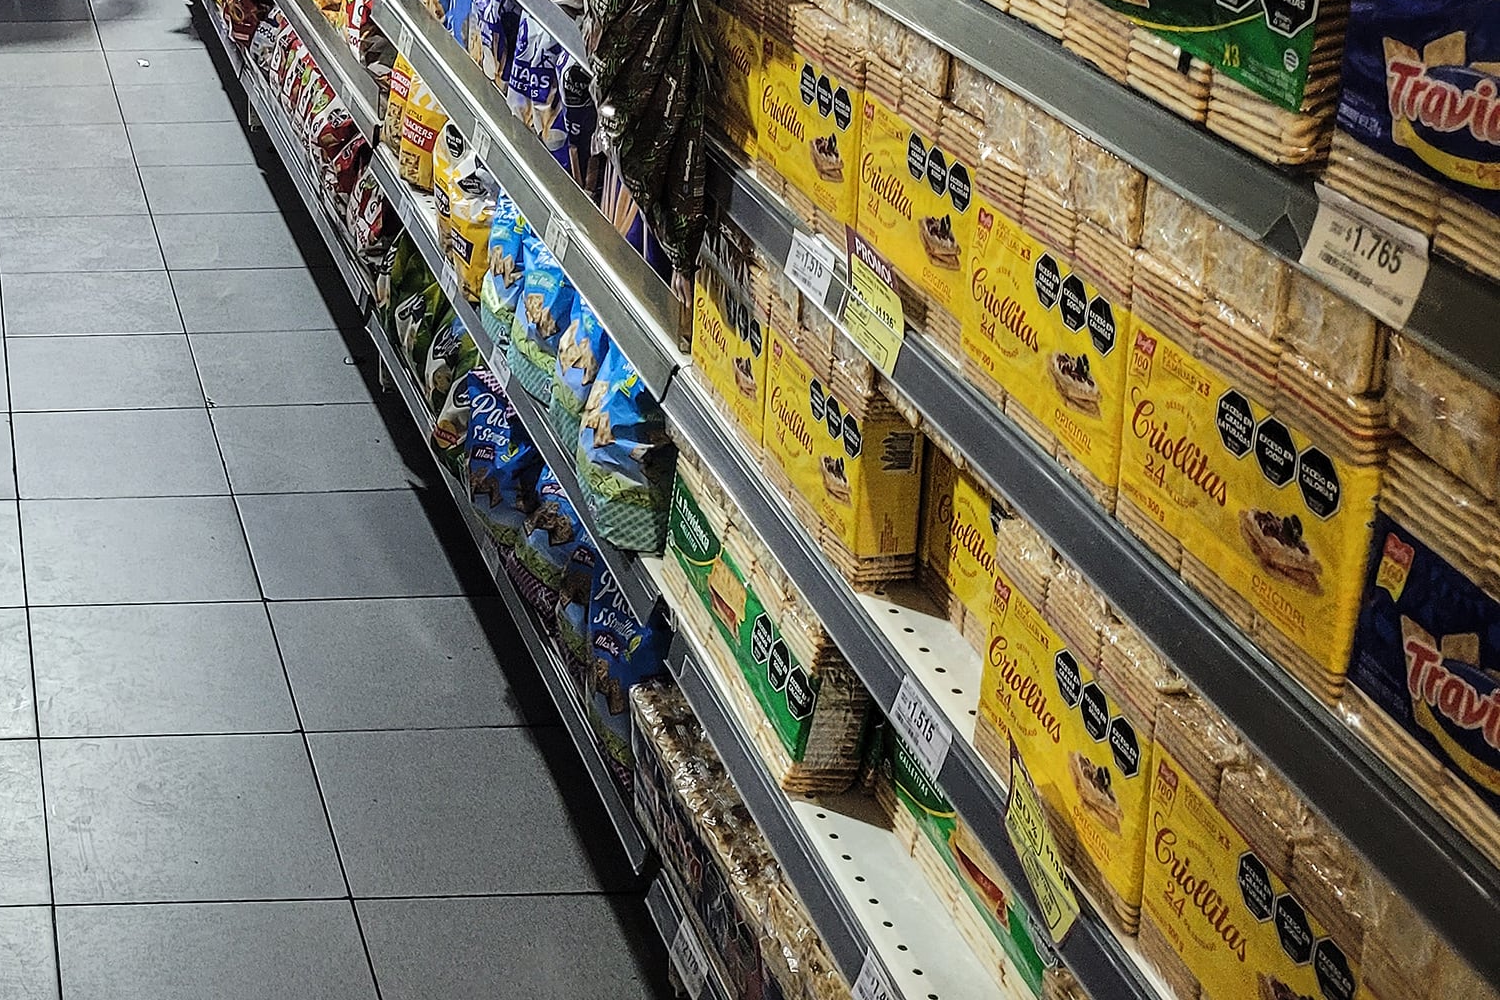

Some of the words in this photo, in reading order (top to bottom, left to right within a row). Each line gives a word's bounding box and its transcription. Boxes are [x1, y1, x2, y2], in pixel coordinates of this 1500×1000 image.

[404, 118, 434, 140] RACKERS
[761, 79, 806, 143] Criollitas
[861, 145, 913, 221] Criollitas
[855, 236, 894, 288] PROMO!
[971, 256, 1039, 353] Criollitas
[1089, 310, 1106, 328] EXCESO
[1106, 321, 1114, 334] EN
[980, 313, 996, 344] 24
[1133, 352, 1149, 371] 160
[1197, 379, 1210, 397] x3
[770, 379, 815, 455] Criollitas
[1054, 408, 1092, 449] ORIGINAL
[1221, 400, 1243, 423] EXCESO
[1243, 416, 1253, 428] EN
[1131, 387, 1228, 508] Criollitas
[1259, 433, 1283, 456] EXCESO
[1283, 450, 1294, 463] EN
[1265, 447, 1285, 466] SODIO
[1144, 454, 1166, 491] 24
[1301, 462, 1326, 485] EXCESO
[1327, 478, 1338, 494] EN
[675, 488, 684, 507] La
[683, 500, 710, 550] Providencia
[938, 494, 998, 579] Criollitas
[1252, 575, 1306, 629] ORIGINAL
[989, 622, 1062, 744] Criollitas
[995, 684, 1012, 714] 24
[899, 750, 929, 798] GALLETITAS
[1153, 811, 1247, 962] Criollitas
[1164, 881, 1186, 919] 24
